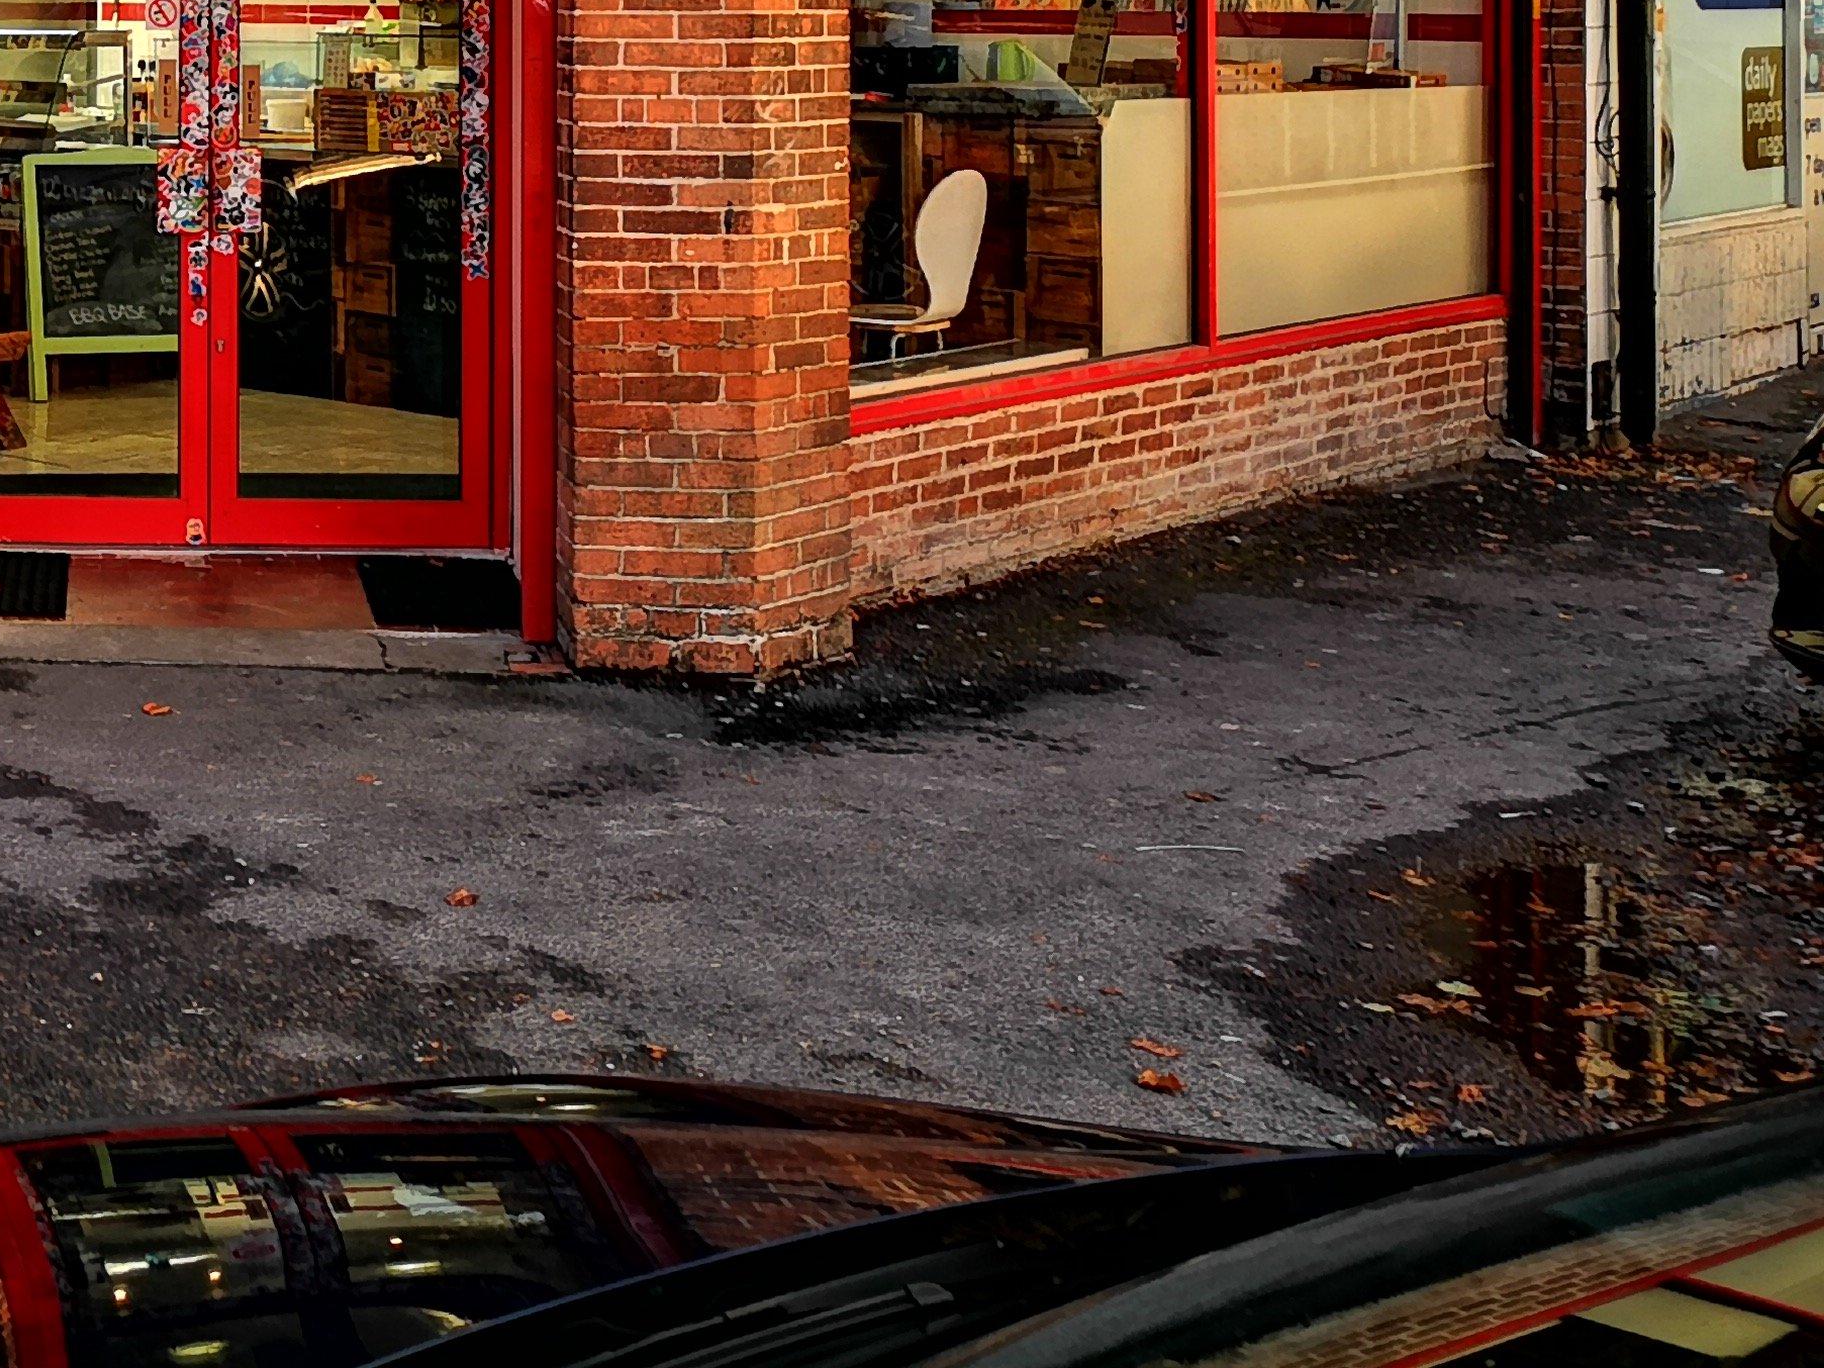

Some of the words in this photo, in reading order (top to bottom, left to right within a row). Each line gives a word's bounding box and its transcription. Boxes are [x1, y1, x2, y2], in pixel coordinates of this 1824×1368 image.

[163, 75, 172, 118] PULL
[1745, 56, 1777, 97] daily
[247, 80, 257, 124] PULL
[1747, 100, 1783, 132] papers
[1758, 135, 1784, 164] mags
